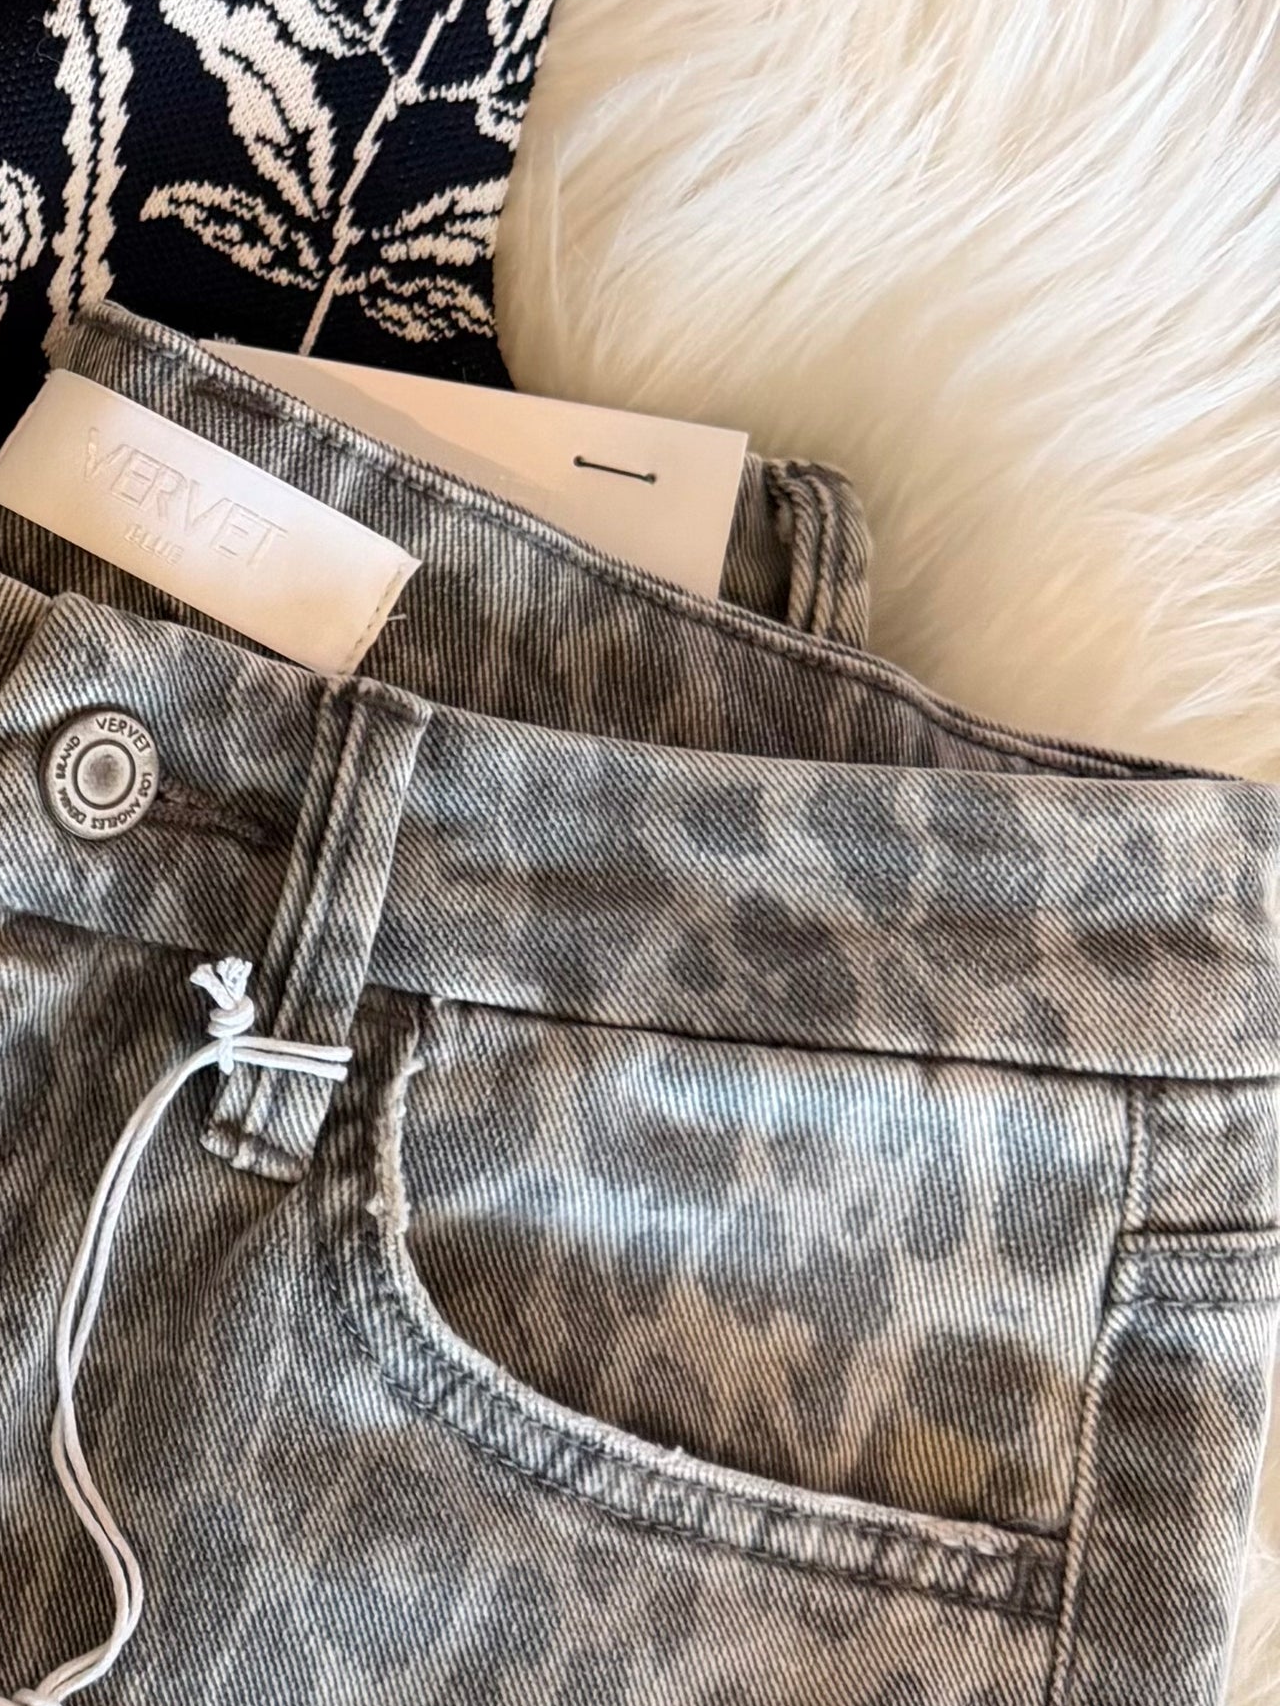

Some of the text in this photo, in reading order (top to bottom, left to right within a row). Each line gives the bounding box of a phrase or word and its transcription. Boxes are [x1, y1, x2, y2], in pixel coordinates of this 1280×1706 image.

[78, 426, 290, 568] VERVET
[123, 524, 186, 566] BLUE
[95, 717, 152, 754] VERVET
[55, 735, 81, 780] BRAND
[90, 801, 142, 830] ANGELES
